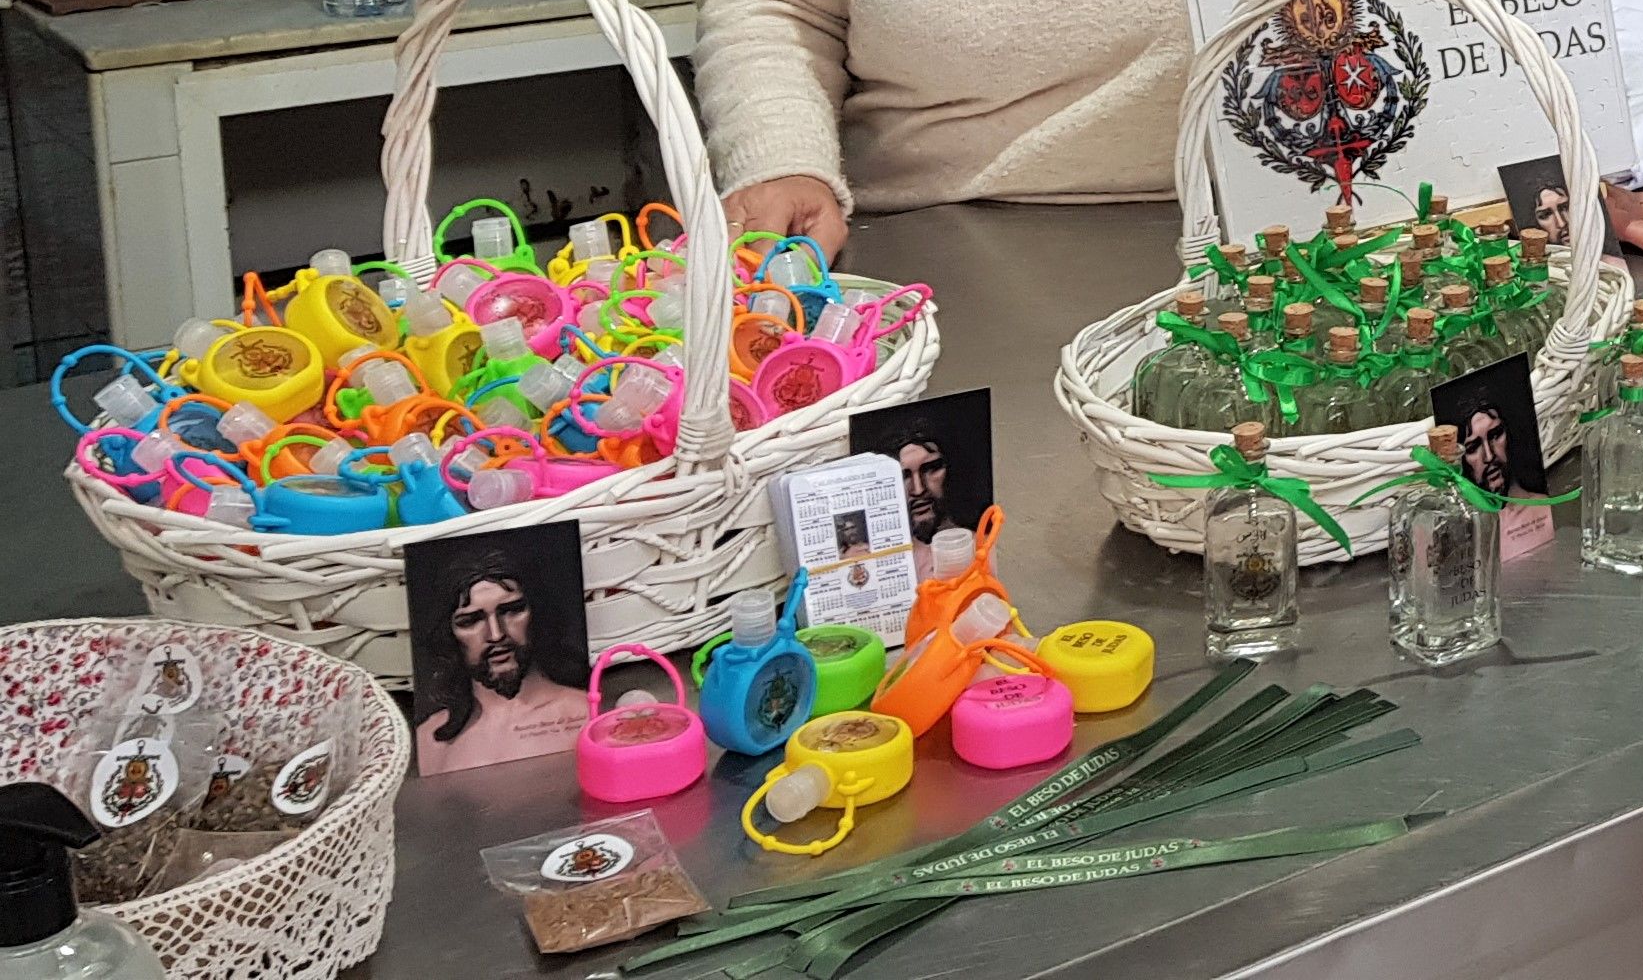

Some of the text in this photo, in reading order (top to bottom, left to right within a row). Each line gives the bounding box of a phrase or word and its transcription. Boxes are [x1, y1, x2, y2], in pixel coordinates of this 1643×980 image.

[1437, 21, 1606, 80] DE JDAS
[1008, 747, 1120, 818] EL BESO DE JUDAS
[985, 862, 1141, 891] EL BESO DE JUDAS
[1026, 841, 1180, 869] EL BESO DE JUDAS
